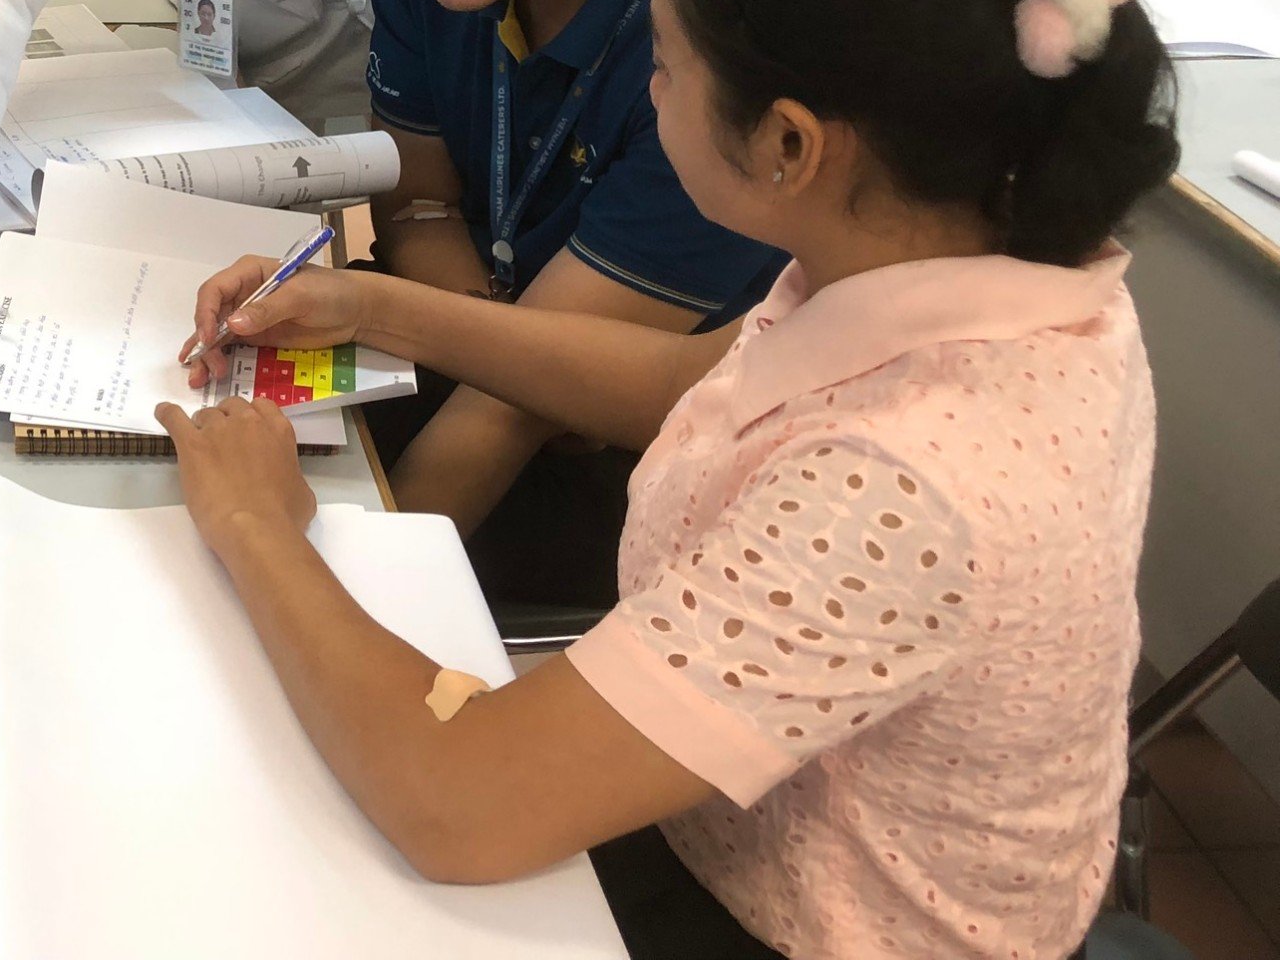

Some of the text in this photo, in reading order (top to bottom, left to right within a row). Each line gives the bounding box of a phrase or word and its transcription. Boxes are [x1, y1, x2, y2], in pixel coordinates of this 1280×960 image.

[497, 85, 506, 105] LTD.
[497, 106, 506, 152] CATERERS
[496, 153, 505, 195] AIRLINES
